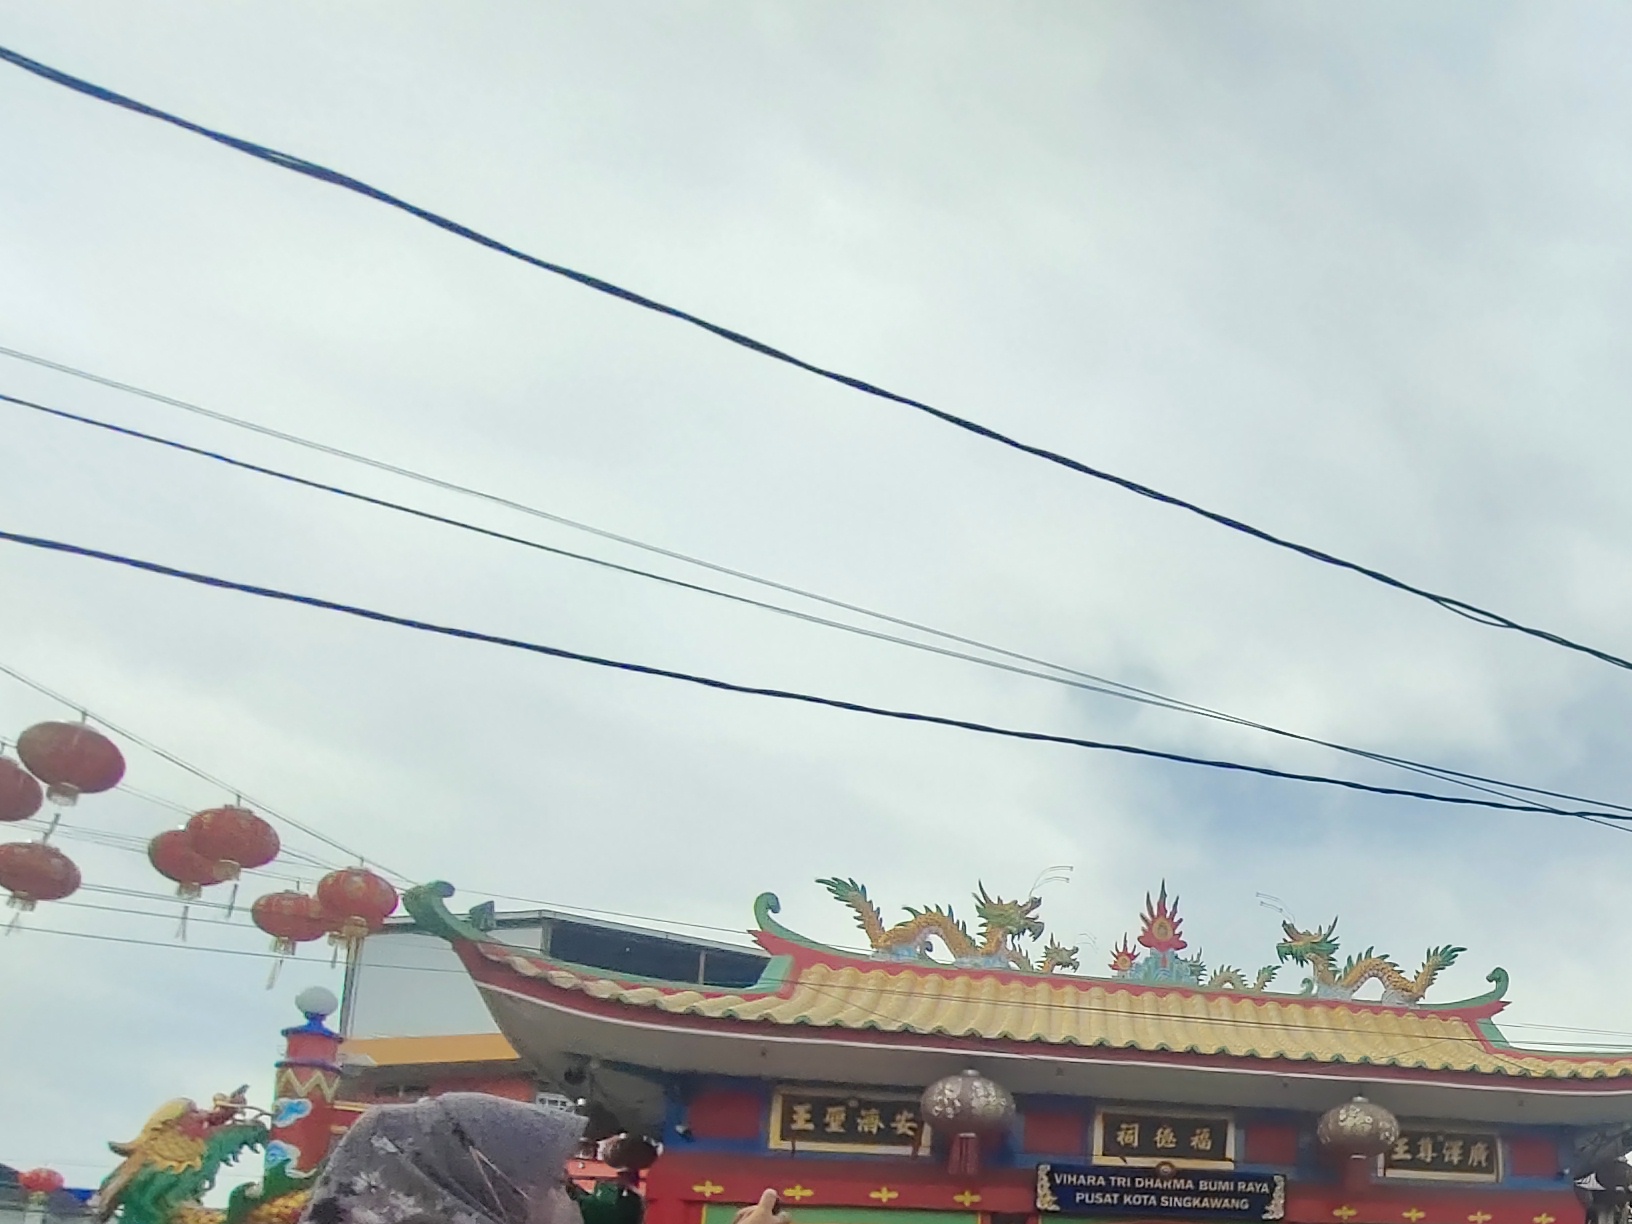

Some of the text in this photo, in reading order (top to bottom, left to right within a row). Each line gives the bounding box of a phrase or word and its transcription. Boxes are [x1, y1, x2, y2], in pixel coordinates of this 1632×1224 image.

[1054, 1173, 1270, 1194] VIHARA TRI DHARMA BUMI RAYA
[1075, 1192, 1250, 1210] PUSAT KOTA SINGKAWANG
